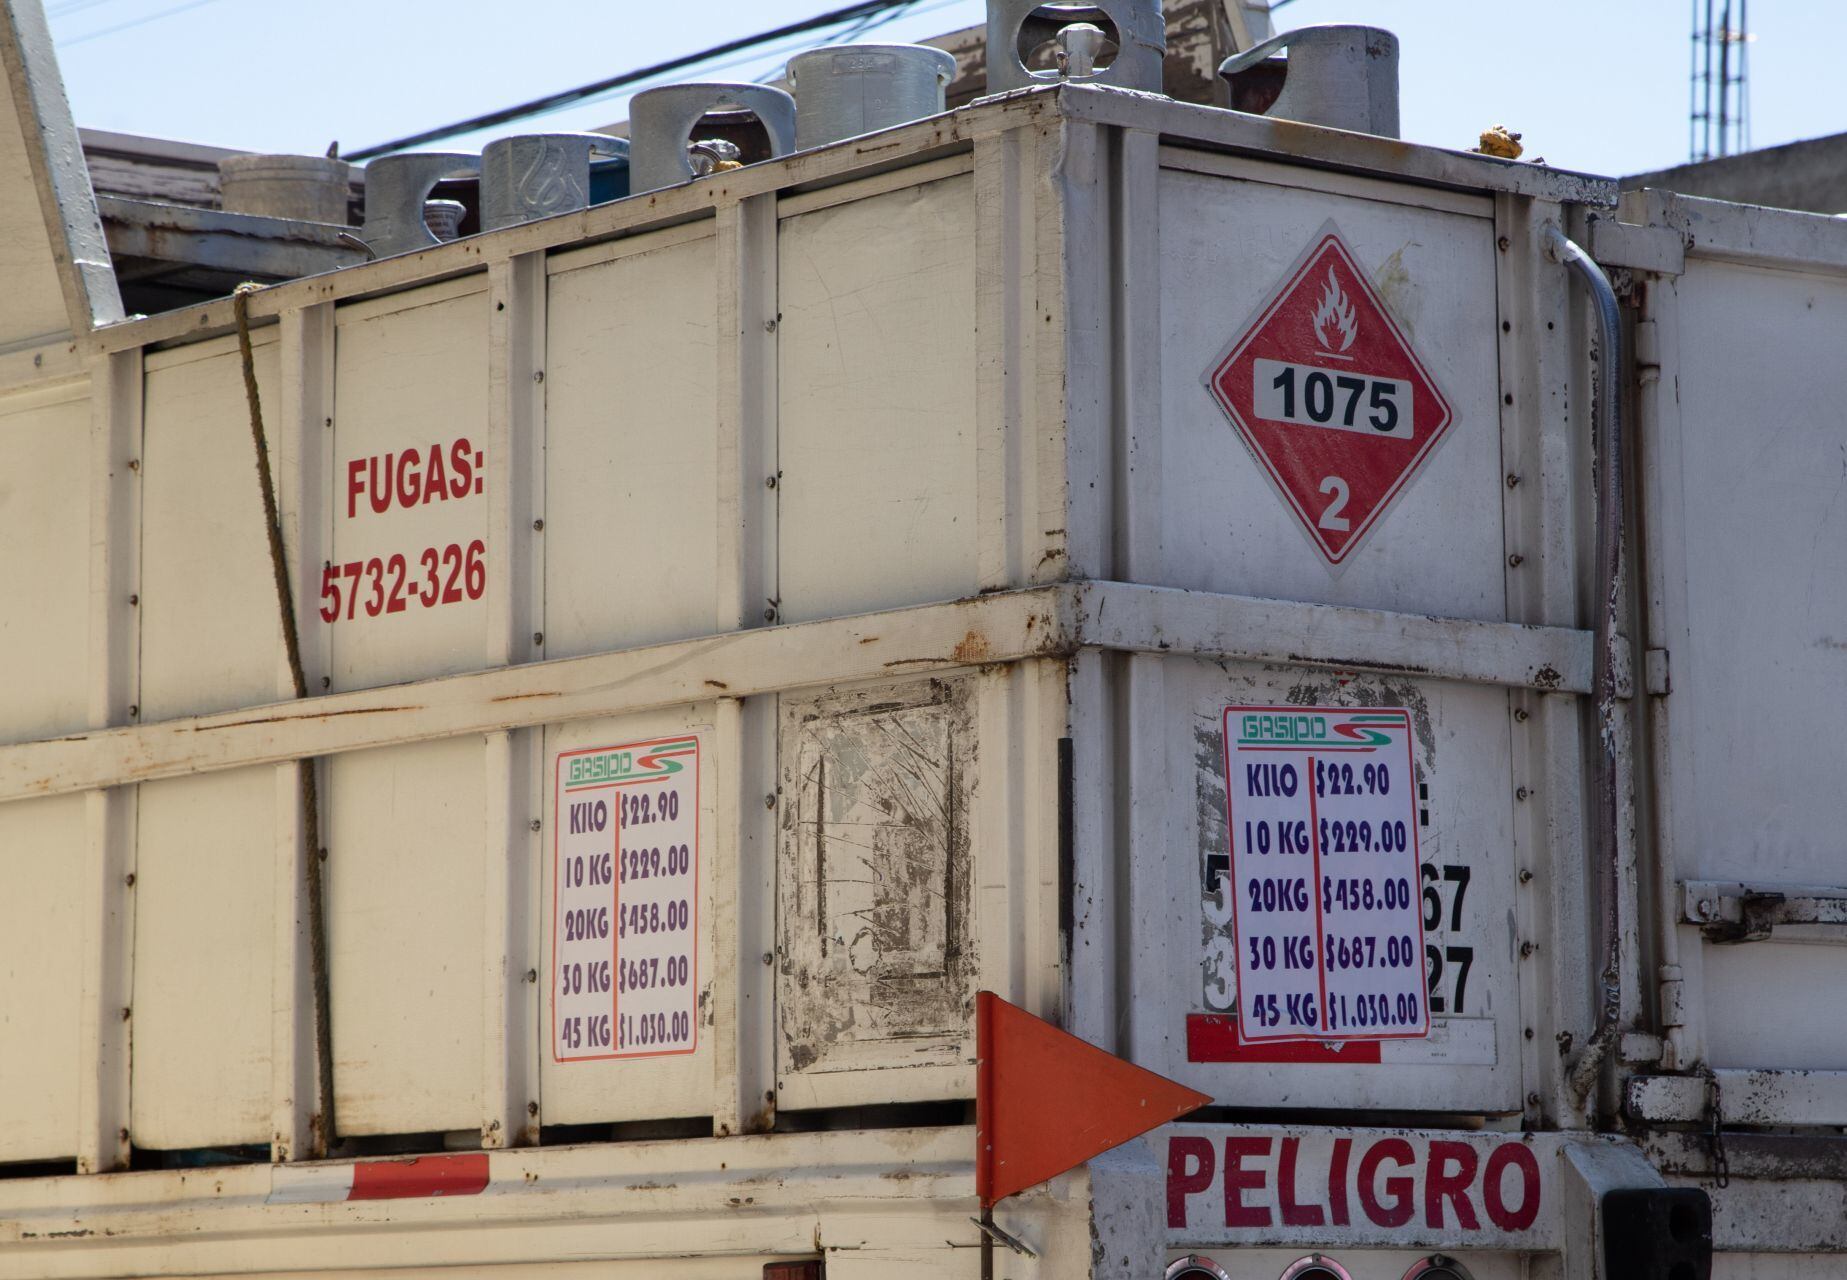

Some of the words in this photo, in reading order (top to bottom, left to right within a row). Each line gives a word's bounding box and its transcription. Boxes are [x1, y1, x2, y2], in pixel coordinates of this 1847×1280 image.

[1273, 366, 1399, 432] 1075
[348, 437, 484, 519] FUGAS:
[1318, 475, 1351, 532] 2
[319, 539, 486, 624] 5732-326
[1246, 763, 1298, 798] KILO
[1316, 760, 1390, 799] $22.90
[570, 799, 608, 835] KILO
[620, 790, 679, 830] $22.90
[1245, 820, 1271, 855] 10
[1277, 820, 1310, 855] KG
[1319, 817, 1407, 856] $229.00
[566, 855, 584, 889] 10
[589, 852, 612, 886] KG
[619, 843, 689, 885] $229.00
[1323, 875, 1410, 914] $458.00
[619, 898, 689, 939] $458.00
[1249, 935, 1277, 971] 30
[1283, 935, 1314, 970] KG
[1325, 933, 1414, 972] $687.00
[562, 962, 582, 996] 30
[587, 960, 611, 993] KG
[619, 954, 688, 994] $687.00
[562, 1016, 581, 1049] 45
[587, 1014, 611, 1047] KG
[619, 1010, 689, 1050] $1.030.00
[1252, 994, 1281, 1027] 45
[1286, 992, 1318, 1027] KG
[1328, 991, 1418, 1030] $1.030.00
[1166, 1135, 1541, 1233] PELIGRO
